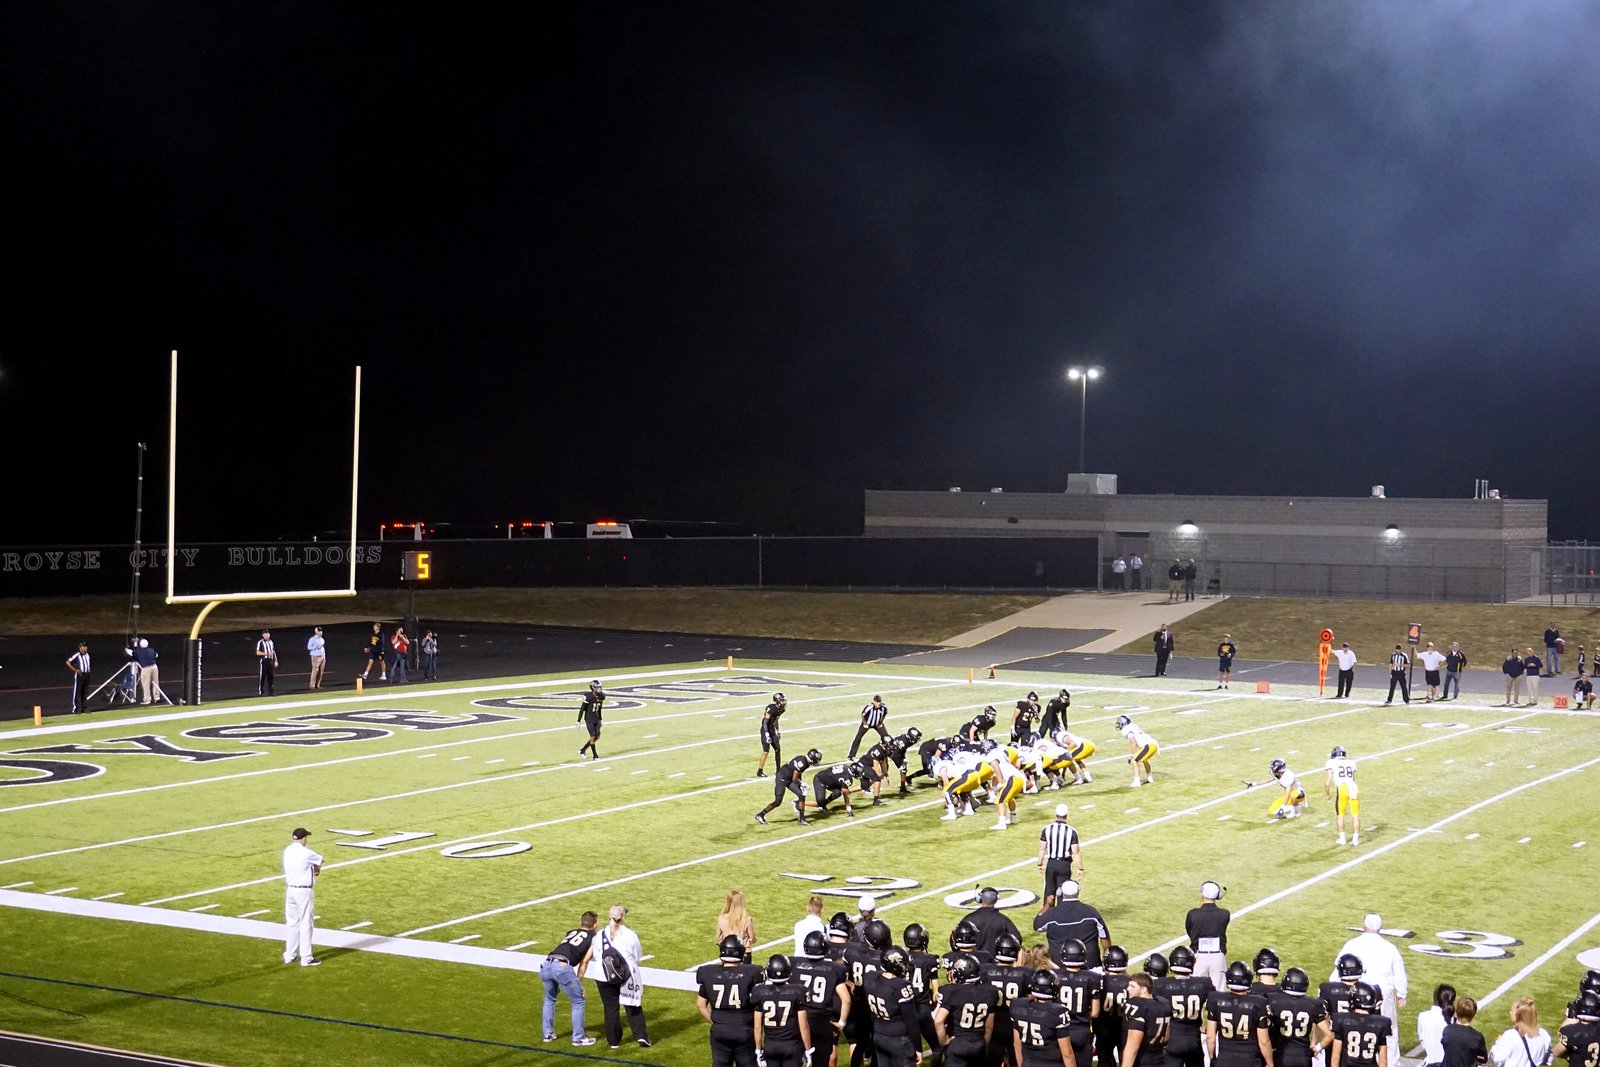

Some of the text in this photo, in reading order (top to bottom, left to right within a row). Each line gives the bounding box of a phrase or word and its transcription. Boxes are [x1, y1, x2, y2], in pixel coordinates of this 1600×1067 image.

[3, 551, 101, 571] ROYSE
[228, 546, 382, 565] BULLDOGS
[417, 553, 429, 579] 5
[1338, 766, 1353, 778] 28
[712, 984, 742, 1009] 74
[800, 974, 827, 1003] 79
[900, 985, 914, 998] 65
[1060, 986, 1084, 1013] 91
[763, 1000, 791, 1027] 27
[867, 994, 891, 1021] 65
[960, 1003, 988, 1029] 62
[1059, 1011, 1071, 1025] 75
[1124, 1003, 1139, 1016] 77
[1171, 994, 1200, 1020] 50
[1018, 1020, 1045, 1046] 75
[1220, 1012, 1249, 1039] 54
[1280, 1010, 1310, 1037] 33
[1347, 1030, 1377, 1059] 83
[1584, 1042, 1600, 1067] 3
